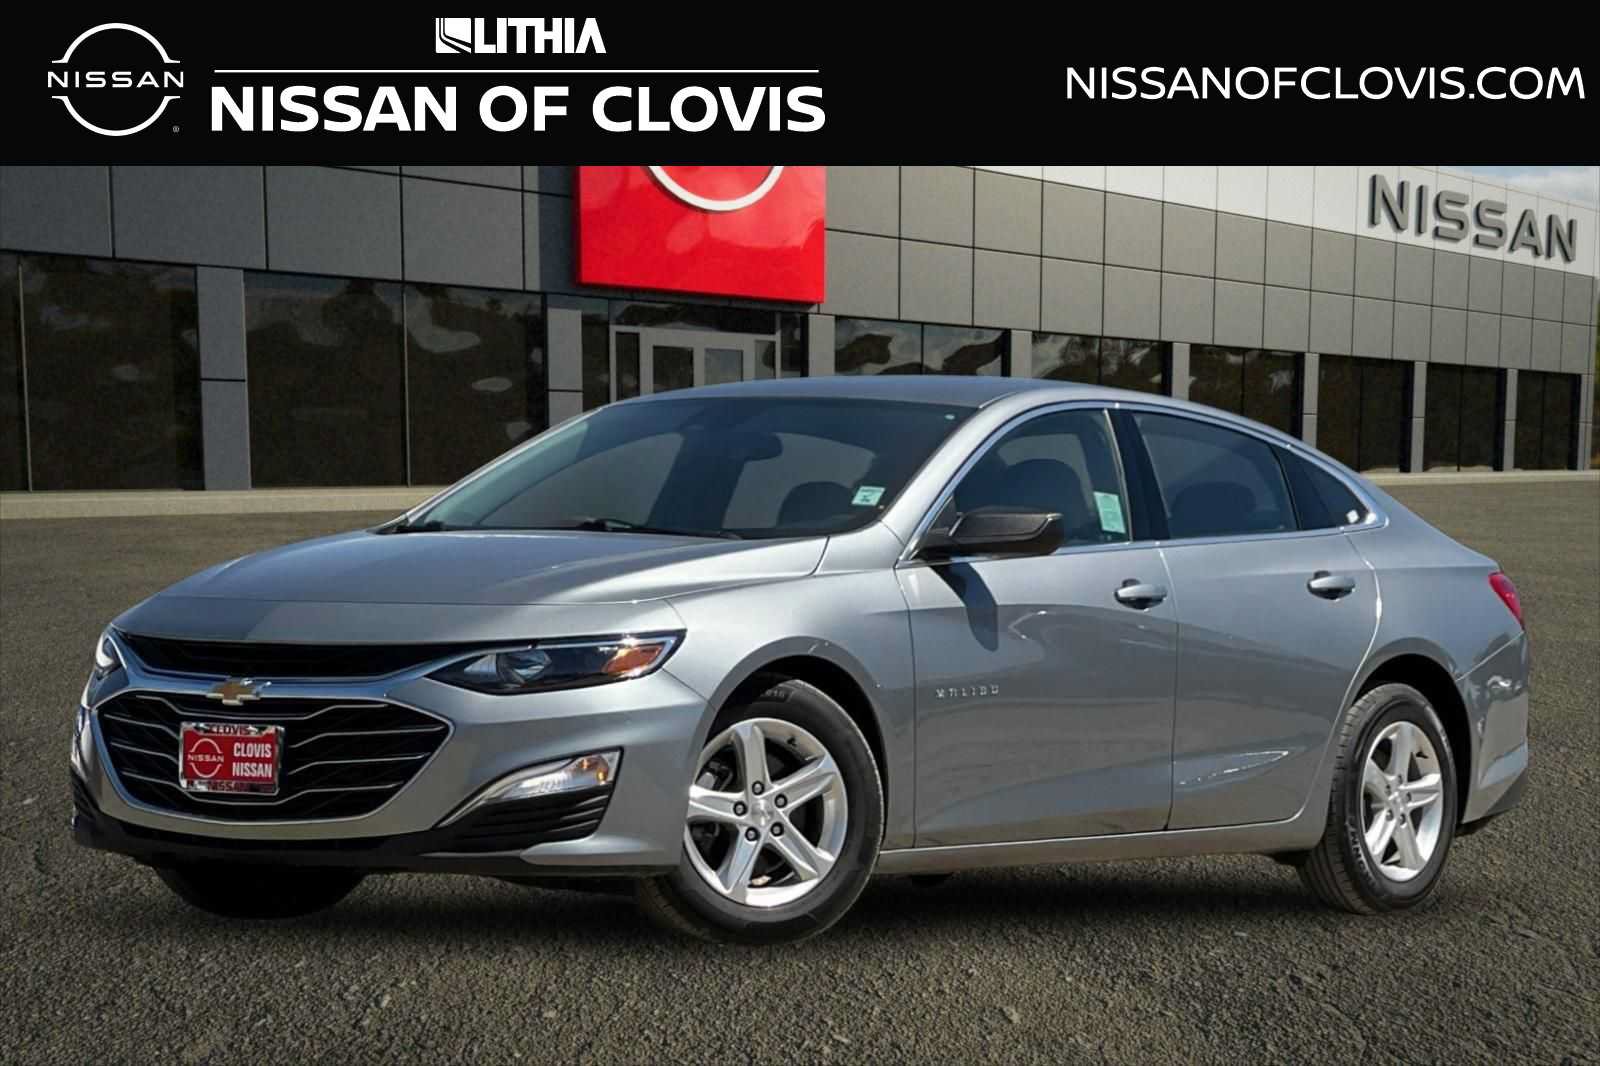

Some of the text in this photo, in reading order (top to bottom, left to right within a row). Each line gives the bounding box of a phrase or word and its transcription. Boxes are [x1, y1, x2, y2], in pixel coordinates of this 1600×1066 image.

[1368, 174, 1577, 263] NISSAN
[187, 753, 225, 763] NISSAN
[233, 742, 272, 758] CLOVIS
[231, 762, 273, 778] NISSAN
